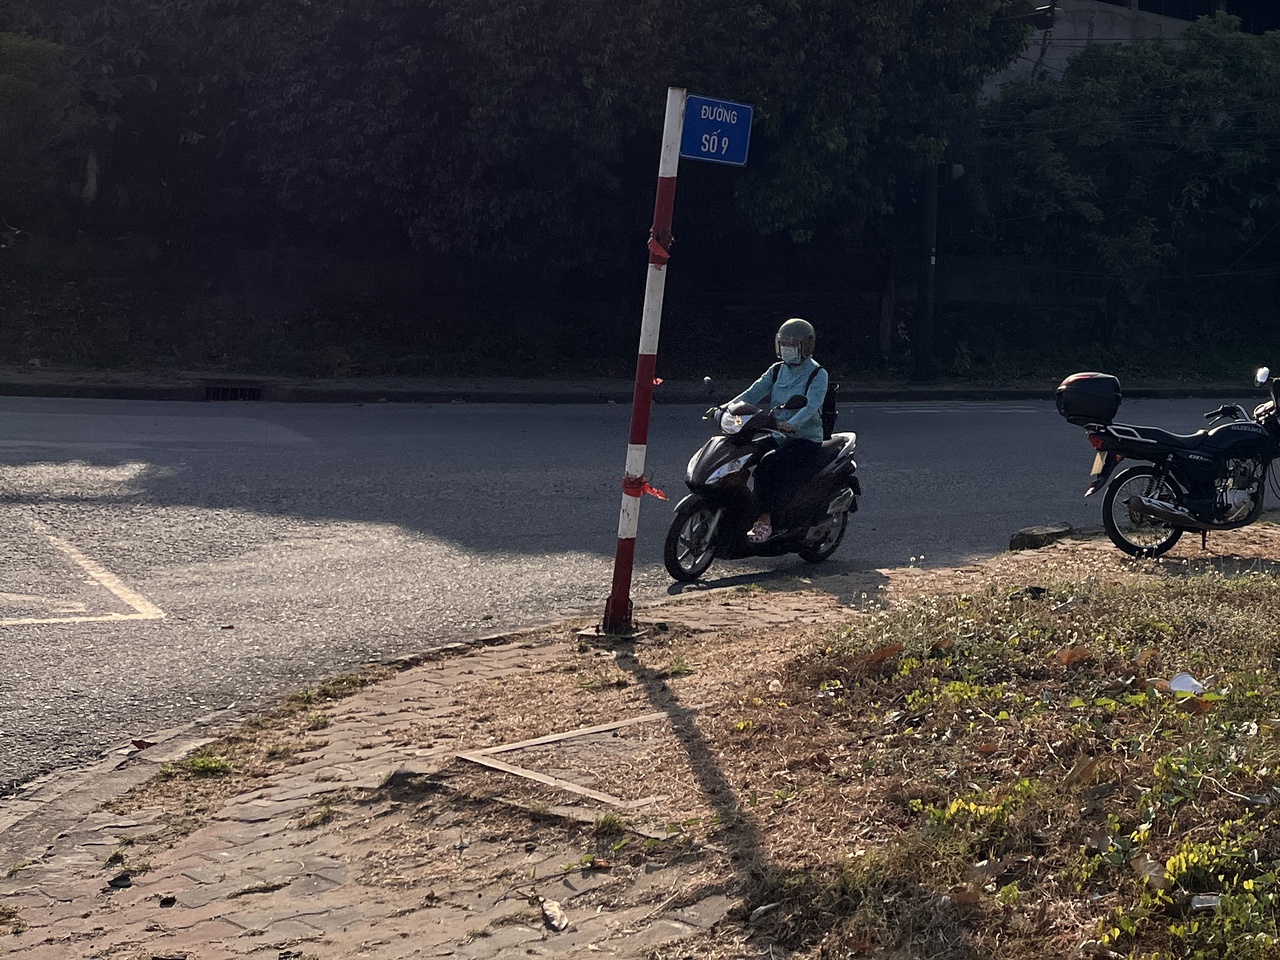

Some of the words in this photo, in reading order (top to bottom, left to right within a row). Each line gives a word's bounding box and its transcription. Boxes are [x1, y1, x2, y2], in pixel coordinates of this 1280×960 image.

[701, 105, 738, 124] ĐƯỜNG
[701, 129, 721, 153] SỐ
[721, 137, 729, 155] 9
